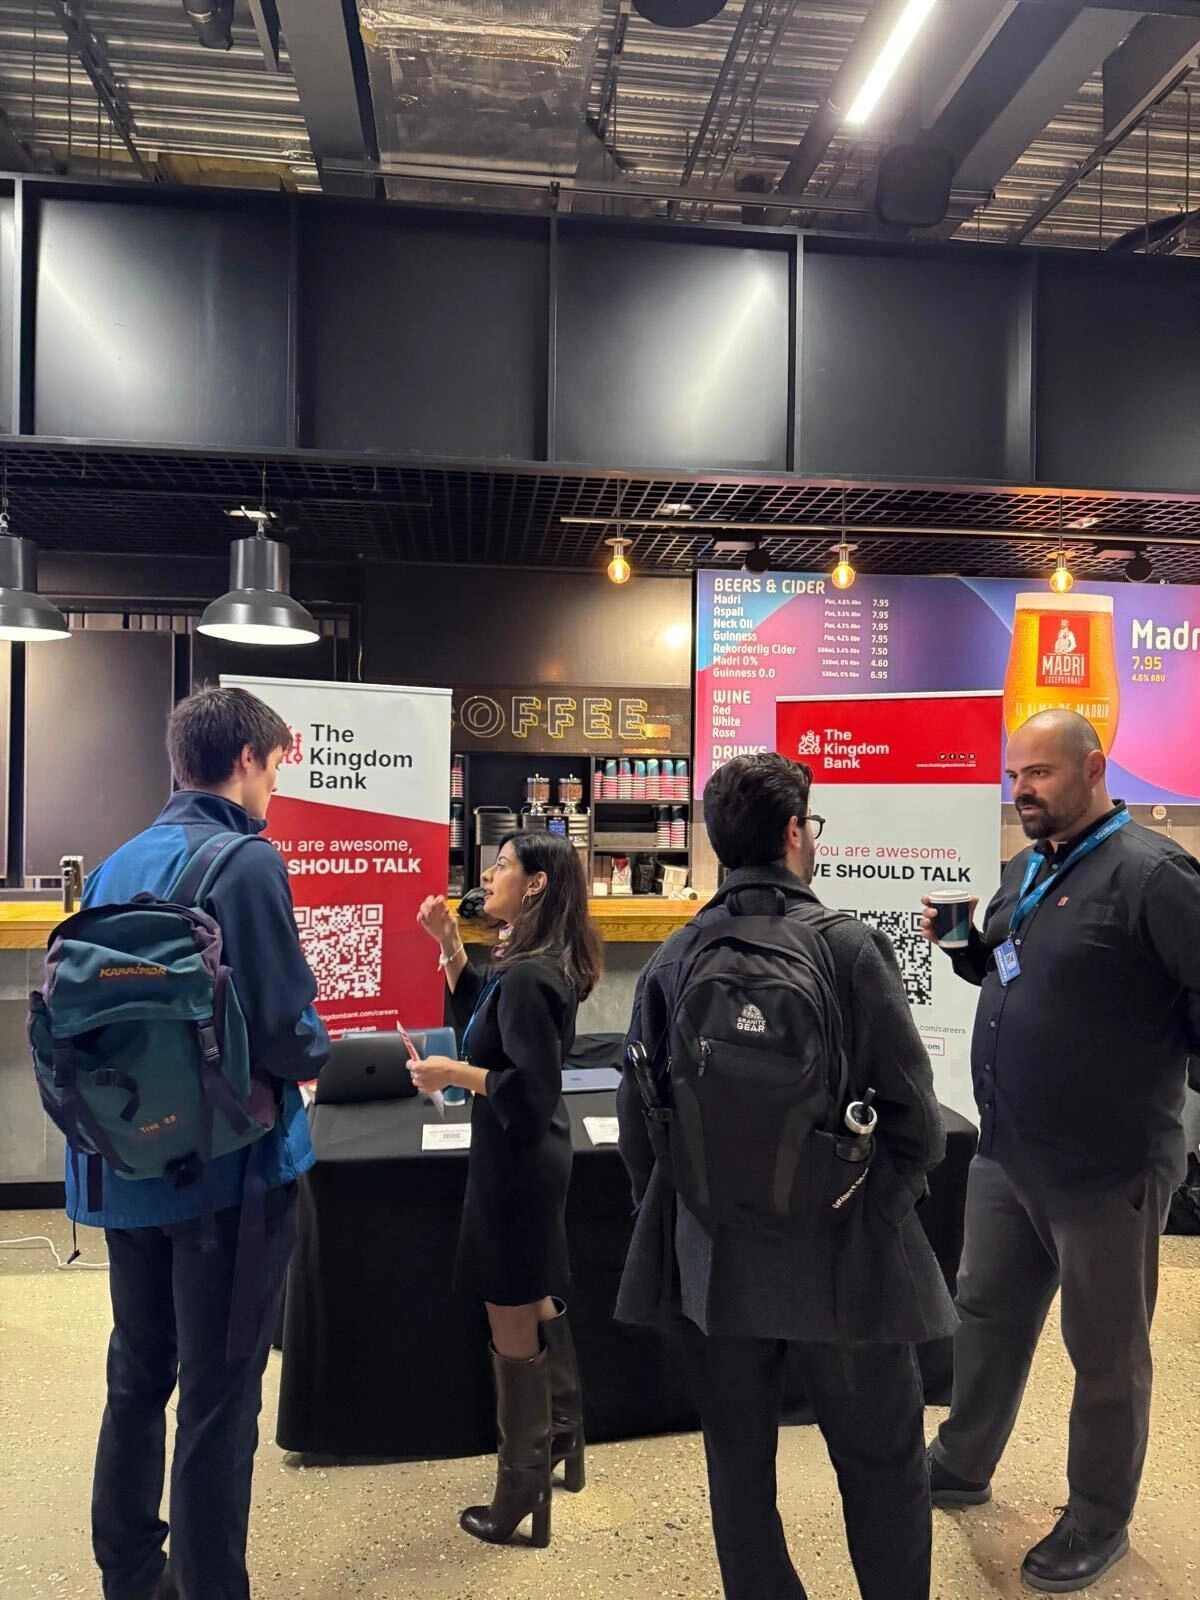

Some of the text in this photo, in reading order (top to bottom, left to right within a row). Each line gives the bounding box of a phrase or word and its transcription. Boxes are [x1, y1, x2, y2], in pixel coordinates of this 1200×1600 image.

[714, 578, 826, 595] BEERS & CIDER
[872, 599, 889, 607] 7.95
[713, 606, 744, 618] Aspall
[872, 611, 889, 619] 7.95
[713, 618, 738, 629] Neck
[740, 618, 753, 629] Oil
[872, 622, 889, 631] 7.95
[713, 631, 758, 641] Guinness
[872, 635, 888, 643] 7.95
[1132, 618, 1200, 651] Madr
[713, 643, 770, 656] Rekorderlig
[772, 644, 798, 655] Cider
[871, 647, 888, 655] 7.50
[712, 656, 740, 666] Madri
[742, 656, 758, 666] 0%
[870, 659, 888, 667] 4.60
[1132, 656, 1162, 670] 7.95
[713, 668, 757, 678] Guinness
[758, 668, 776, 678] 0.0
[870, 671, 888, 679] 6.95
[713, 690, 751, 704] WINE
[712, 705, 731, 715] Red
[451, 696, 648, 740] OFFEE
[712, 715, 741, 727] White
[310, 724, 354, 743] The
[712, 727, 736, 738] Rose
[824, 728, 852, 741] The
[824, 743, 890, 757] Kingdom
[310, 748, 413, 771] Kingdom
[824, 757, 861, 769] Bank
[309, 771, 368, 790] Bank
[267, 838, 413, 854] ou are awesome,
[844, 846, 870, 858] are
[876, 847, 961, 862] awesome,
[288, 858, 422, 875] SHOULD TALK
[836, 865, 915, 880] SHOULD
[920, 866, 972, 882] TALK
[736, 1023, 765, 1032] GEAR
[737, 1016, 766, 1026] GRANITE
